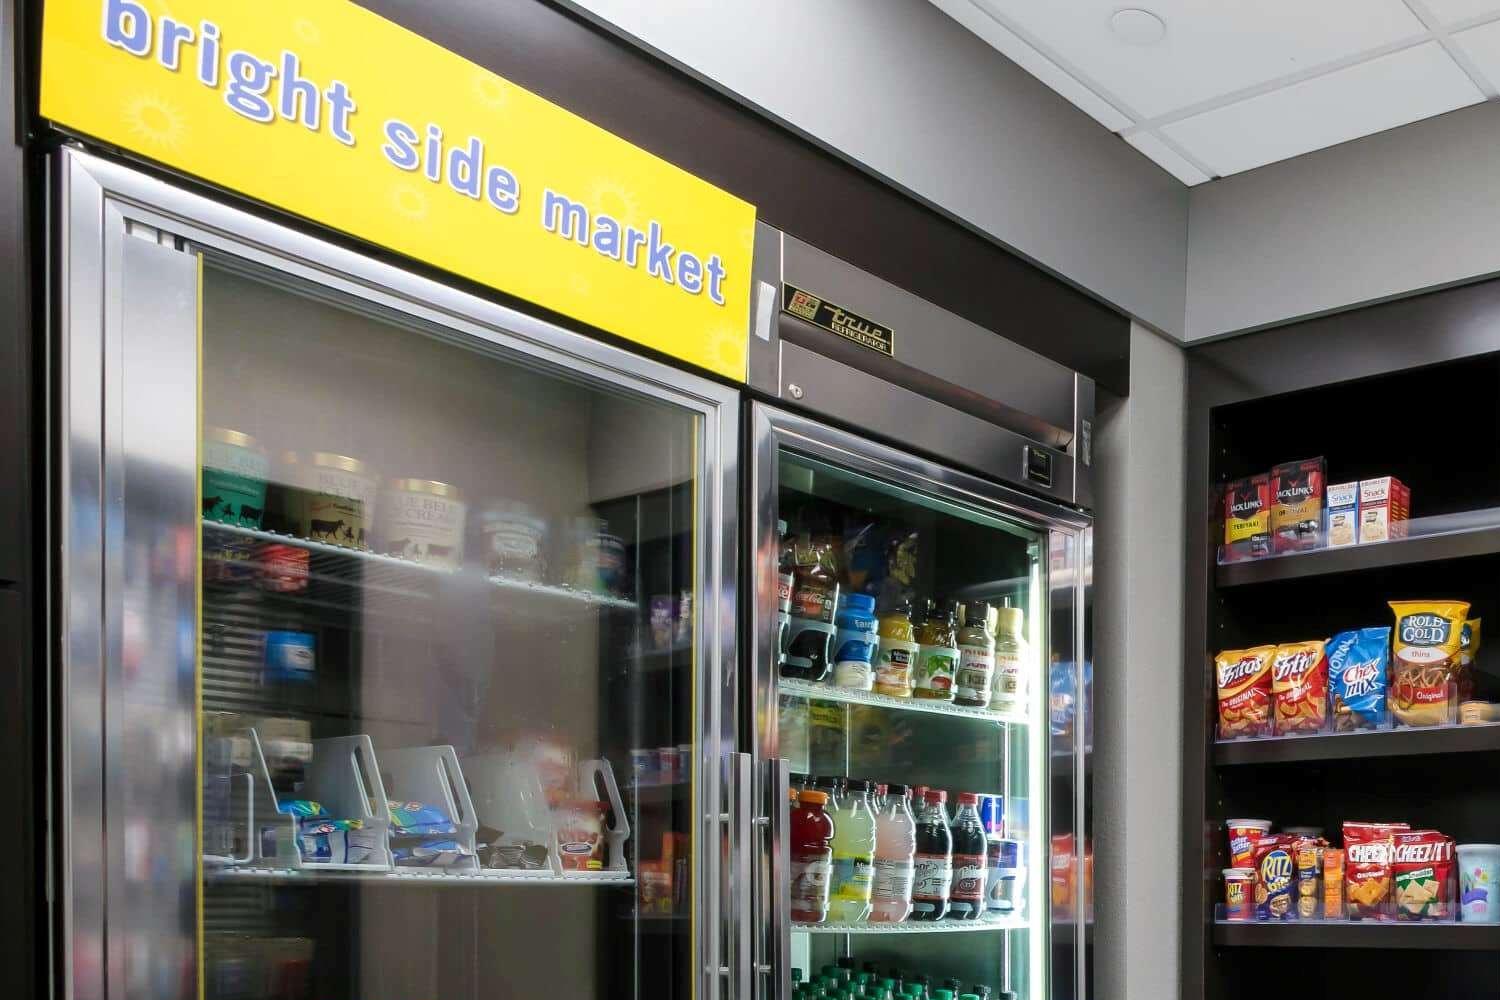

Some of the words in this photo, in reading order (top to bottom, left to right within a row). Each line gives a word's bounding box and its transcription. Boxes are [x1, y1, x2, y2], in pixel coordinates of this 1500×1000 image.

[103, 0, 358, 146] bright
[382, 116, 520, 214] side
[541, 187, 727, 306] market
[824, 304, 883, 339] true
[831, 321, 888, 352] REFRIGERATOR
[1291, 487, 1315, 498] LINK'S
[1363, 488, 1385, 498] Snack
[1232, 520, 1259, 531] TERIYAKI
[1409, 615, 1444, 627] ROLD
[1402, 627, 1444, 643] GOLD
[1218, 657, 1264, 688] Fritos
[1343, 658, 1381, 683] Chex
[1228, 687, 1257, 707] ORIGINAL
[1416, 690, 1444, 701] Original
[1262, 855, 1292, 882] RITZ
